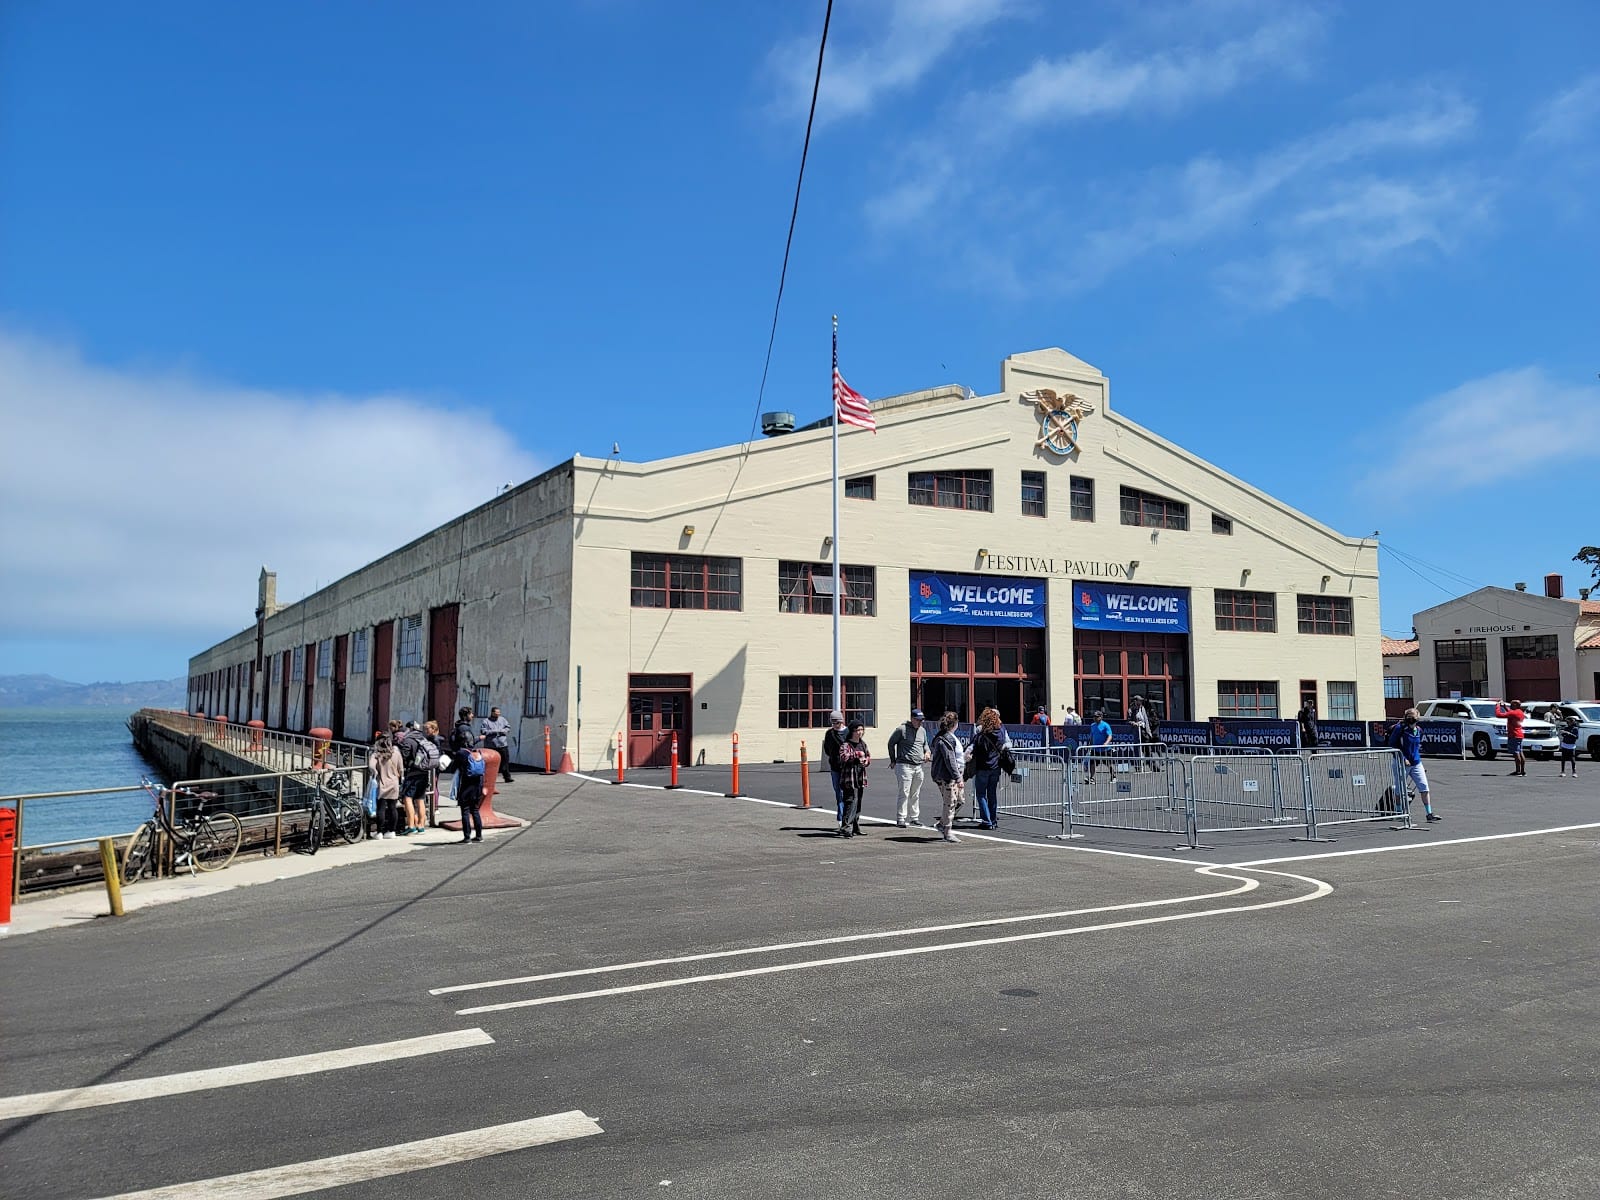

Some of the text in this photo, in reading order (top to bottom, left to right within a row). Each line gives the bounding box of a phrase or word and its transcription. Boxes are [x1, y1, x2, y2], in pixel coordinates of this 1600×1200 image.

[987, 554, 1130, 578] FESTIVAL PAVILION
[949, 585, 1034, 604] WELCOME
[1106, 594, 1179, 612] WELCOME
[971, 609, 990, 617] HEALTH
[994, 610, 1020, 618] WELLNESS
[1469, 625, 1516, 633] FIREHOUSE
[1252, 728, 1290, 736] FRANCISCO
[1324, 725, 1362, 733] FRANCISCO
[1423, 727, 1457, 735] ANCISCO
[1160, 734, 1207, 744] MARATHON
[1238, 735, 1291, 745] MARATHON
[1318, 732, 1362, 741] ARATHON
[1421, 734, 1457, 743] ATHON
